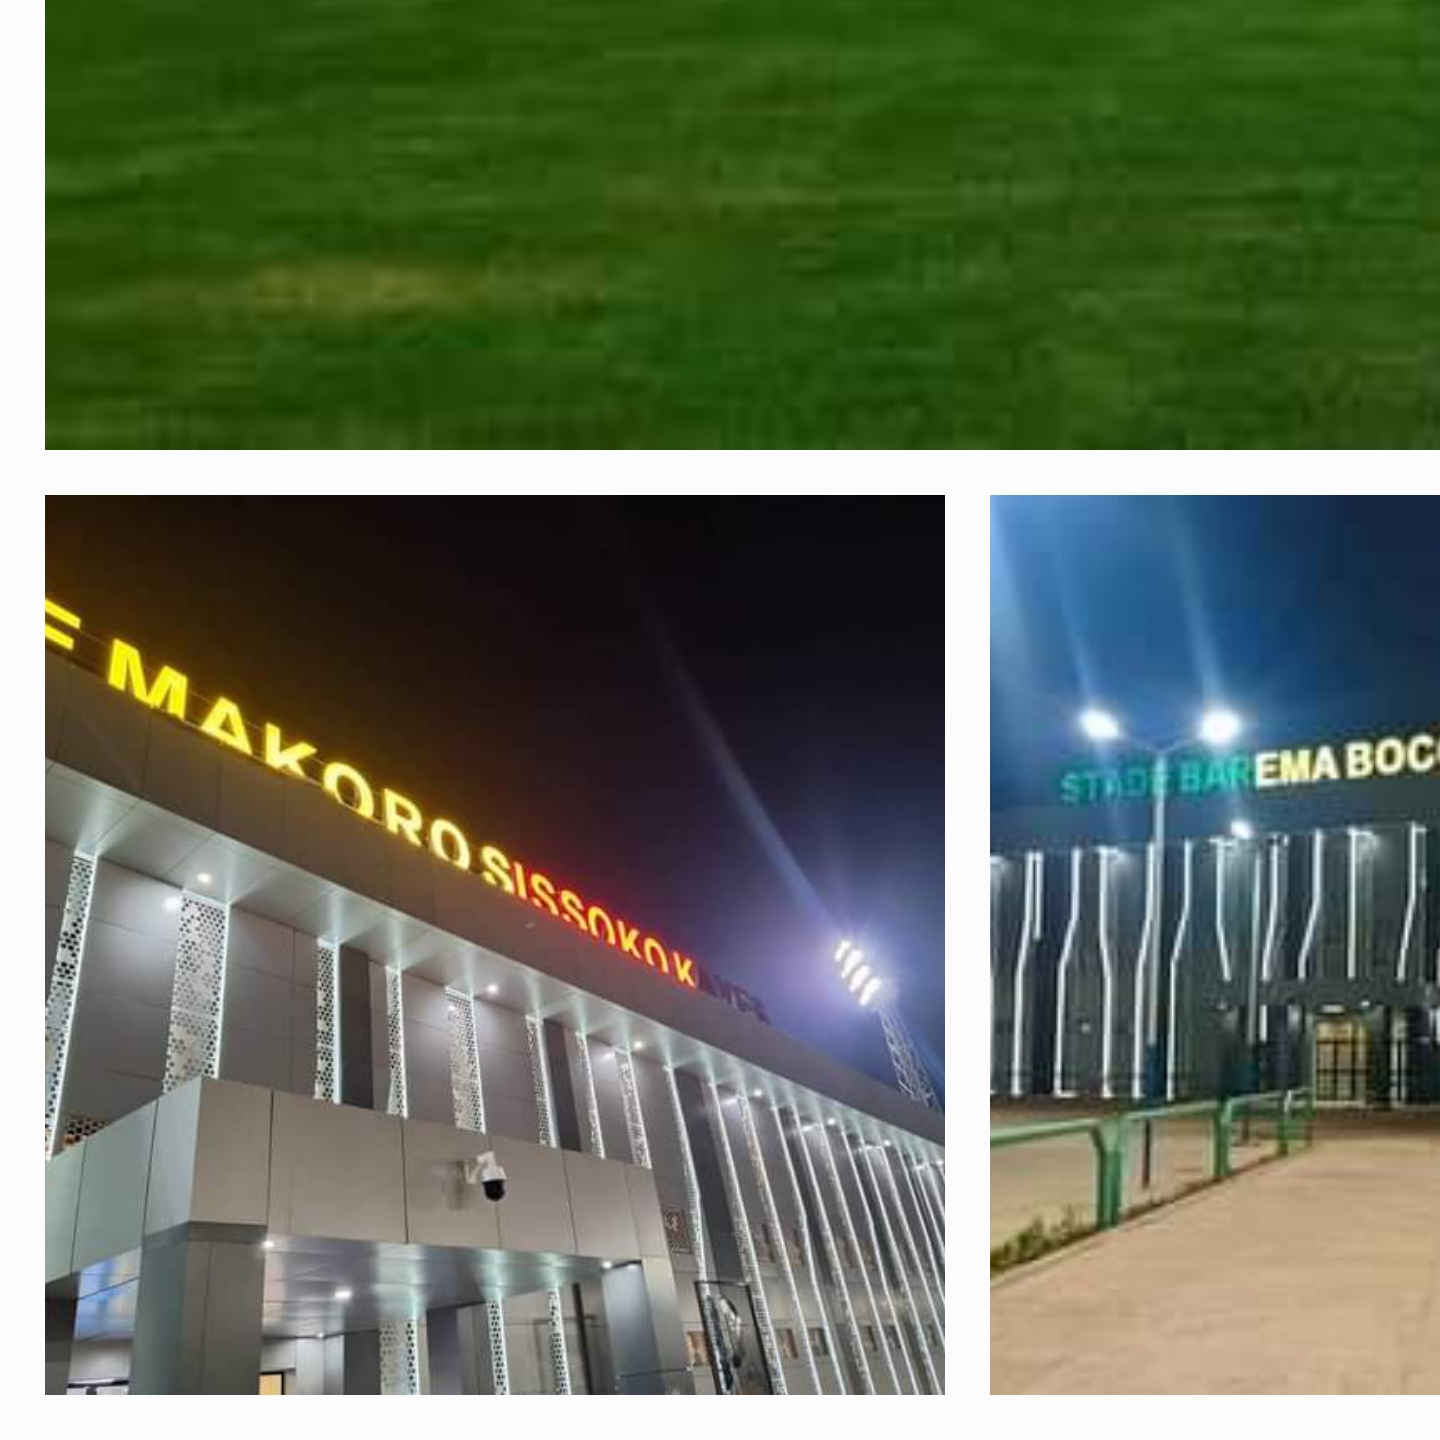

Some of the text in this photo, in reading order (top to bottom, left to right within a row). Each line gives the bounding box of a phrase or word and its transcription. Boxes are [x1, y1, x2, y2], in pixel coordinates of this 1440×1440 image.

[107, 637, 472, 872] MAKORO
[481, 845, 669, 974] SISSOKO
[1179, 744, 1338, 795] BAREMA
